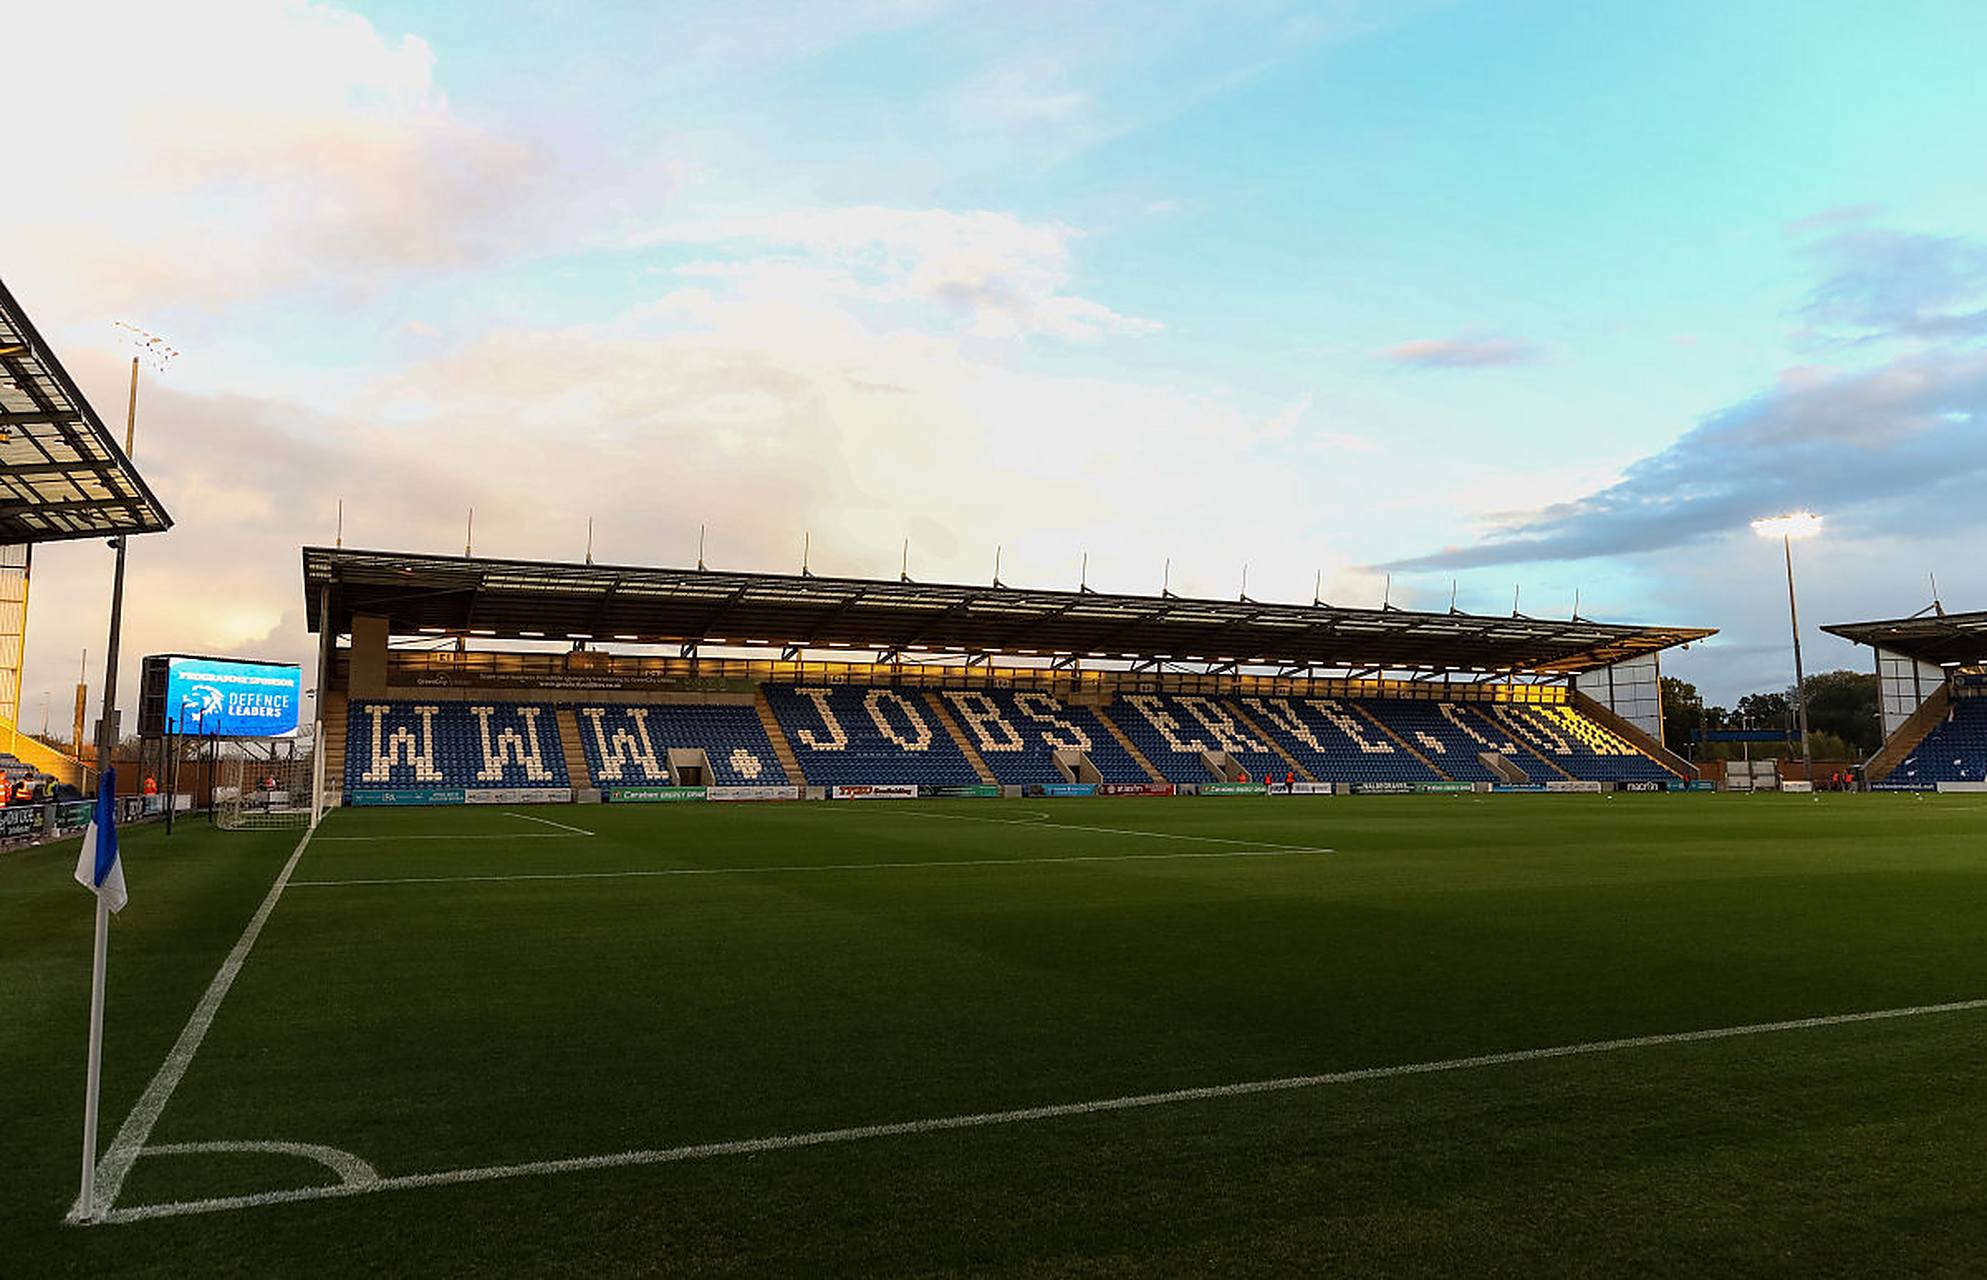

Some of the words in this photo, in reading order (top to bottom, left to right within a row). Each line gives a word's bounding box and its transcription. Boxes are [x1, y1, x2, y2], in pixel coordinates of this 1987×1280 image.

[229, 692, 289, 708] DEFENCE
[228, 706, 282, 718] LEADERS
[1627, 781, 1658, 791] macron
